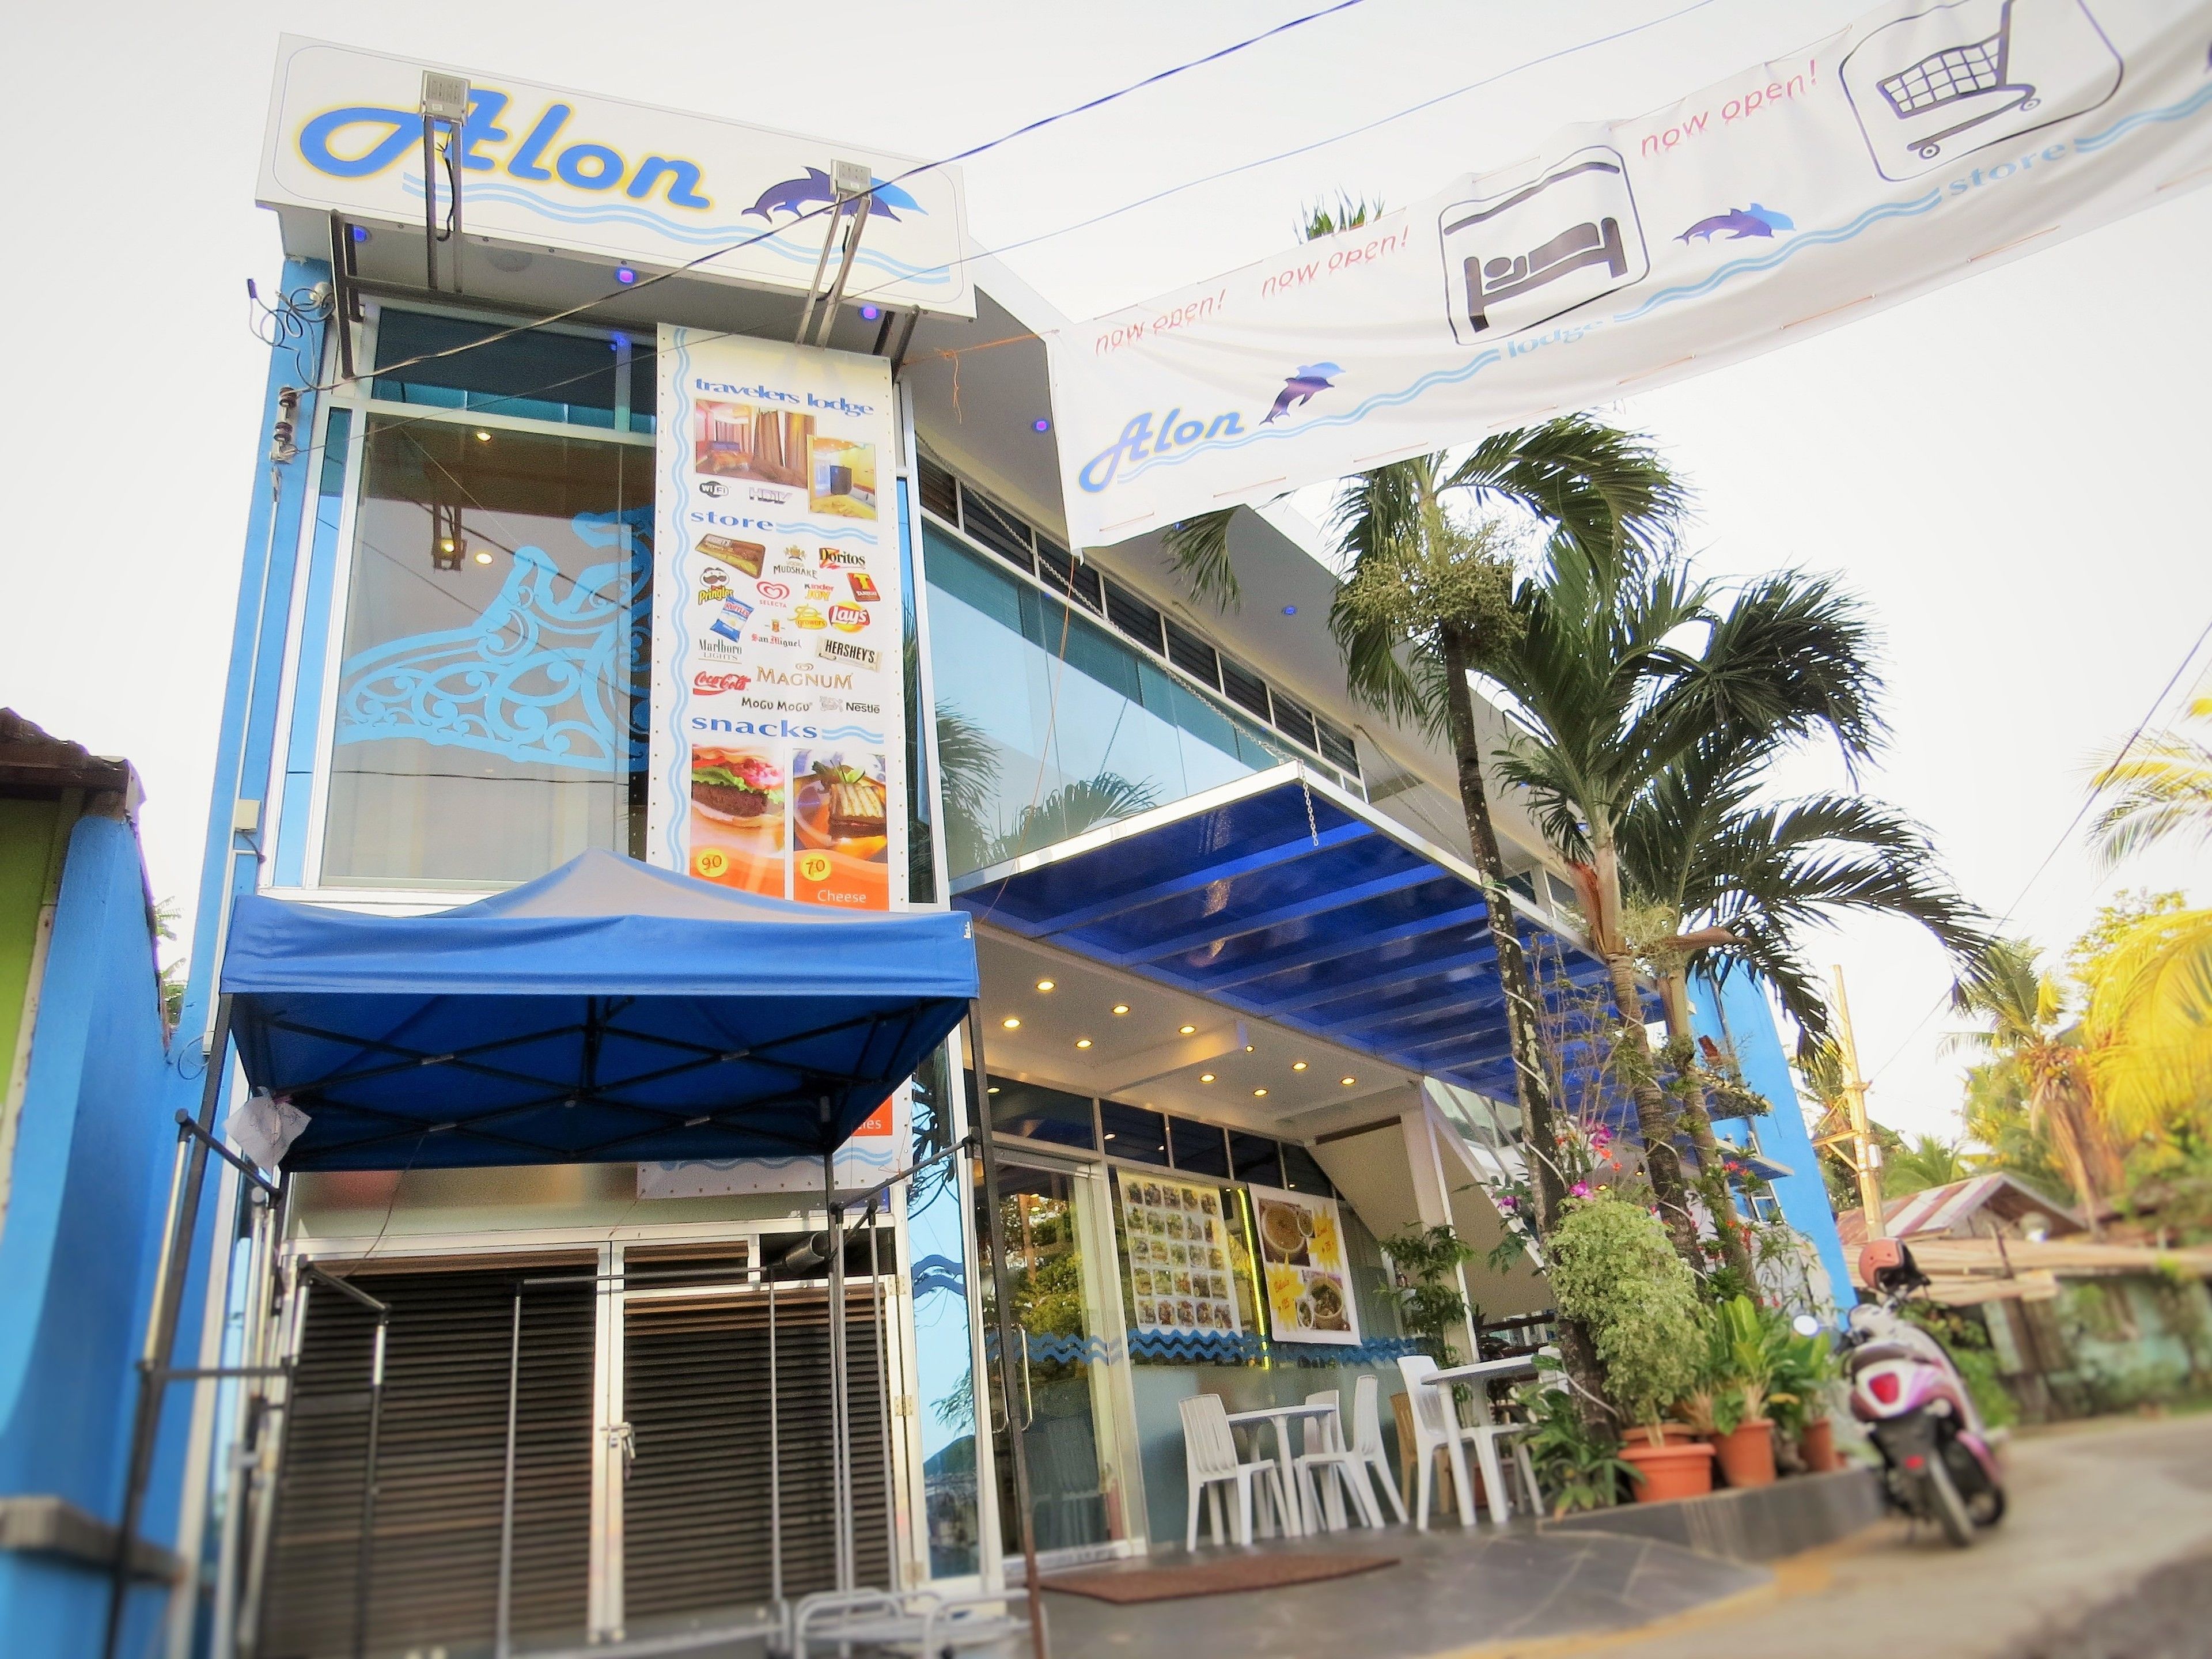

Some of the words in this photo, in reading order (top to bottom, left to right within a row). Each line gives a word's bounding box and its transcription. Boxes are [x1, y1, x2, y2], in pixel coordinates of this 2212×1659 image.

[1642, 111, 1709, 157] now
[1721, 59, 1816, 124] open!
[300, 89, 711, 209] Alon
[1948, 142, 2066, 198] store
[1262, 262, 1320, 298] now
[1328, 225, 1408, 275] open!
[1096, 322, 1145, 356] now
[1153, 289, 1226, 334] open!
[1507, 321, 1603, 358] lodge
[695, 378, 800, 403] travelers
[808, 393, 874, 417] lodge
[1079, 408, 1244, 493] Alon
[691, 511, 774, 531] store
[819, 547, 865, 567] Doritos
[759, 600, 787, 608] SELECTA
[699, 638, 742, 654] Marlboro
[751, 634, 768, 643] San
[770, 635, 802, 649] Miguel
[825, 639, 875, 664] HERSHEY'S
[704, 652, 738, 661] LIGHTS
[756, 665, 853, 690] MAGNUM
[692, 717, 818, 739] snacks
[817, 889, 866, 904] Cheese
